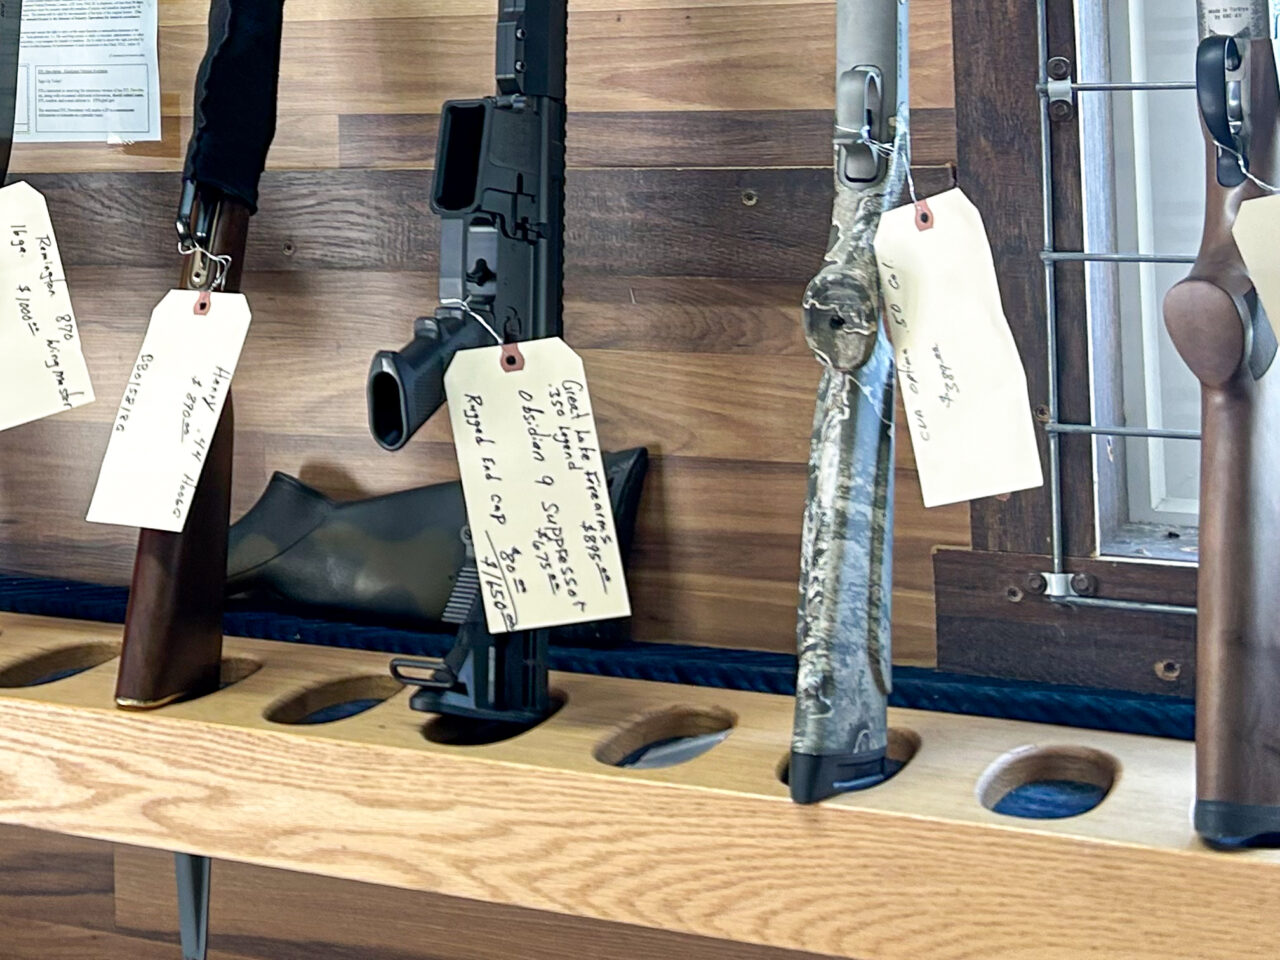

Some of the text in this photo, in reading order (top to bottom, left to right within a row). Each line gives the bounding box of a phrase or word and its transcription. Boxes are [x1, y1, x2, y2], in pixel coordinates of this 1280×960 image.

[35, 236, 72, 341] Remington 870
[457, 393, 496, 446] Rugged
[481, 457, 503, 481] End
[518, 390, 587, 613] Obsidian 9 Suppressor
[561, 380, 590, 420] Great
[585, 469, 613, 545] Firearms
